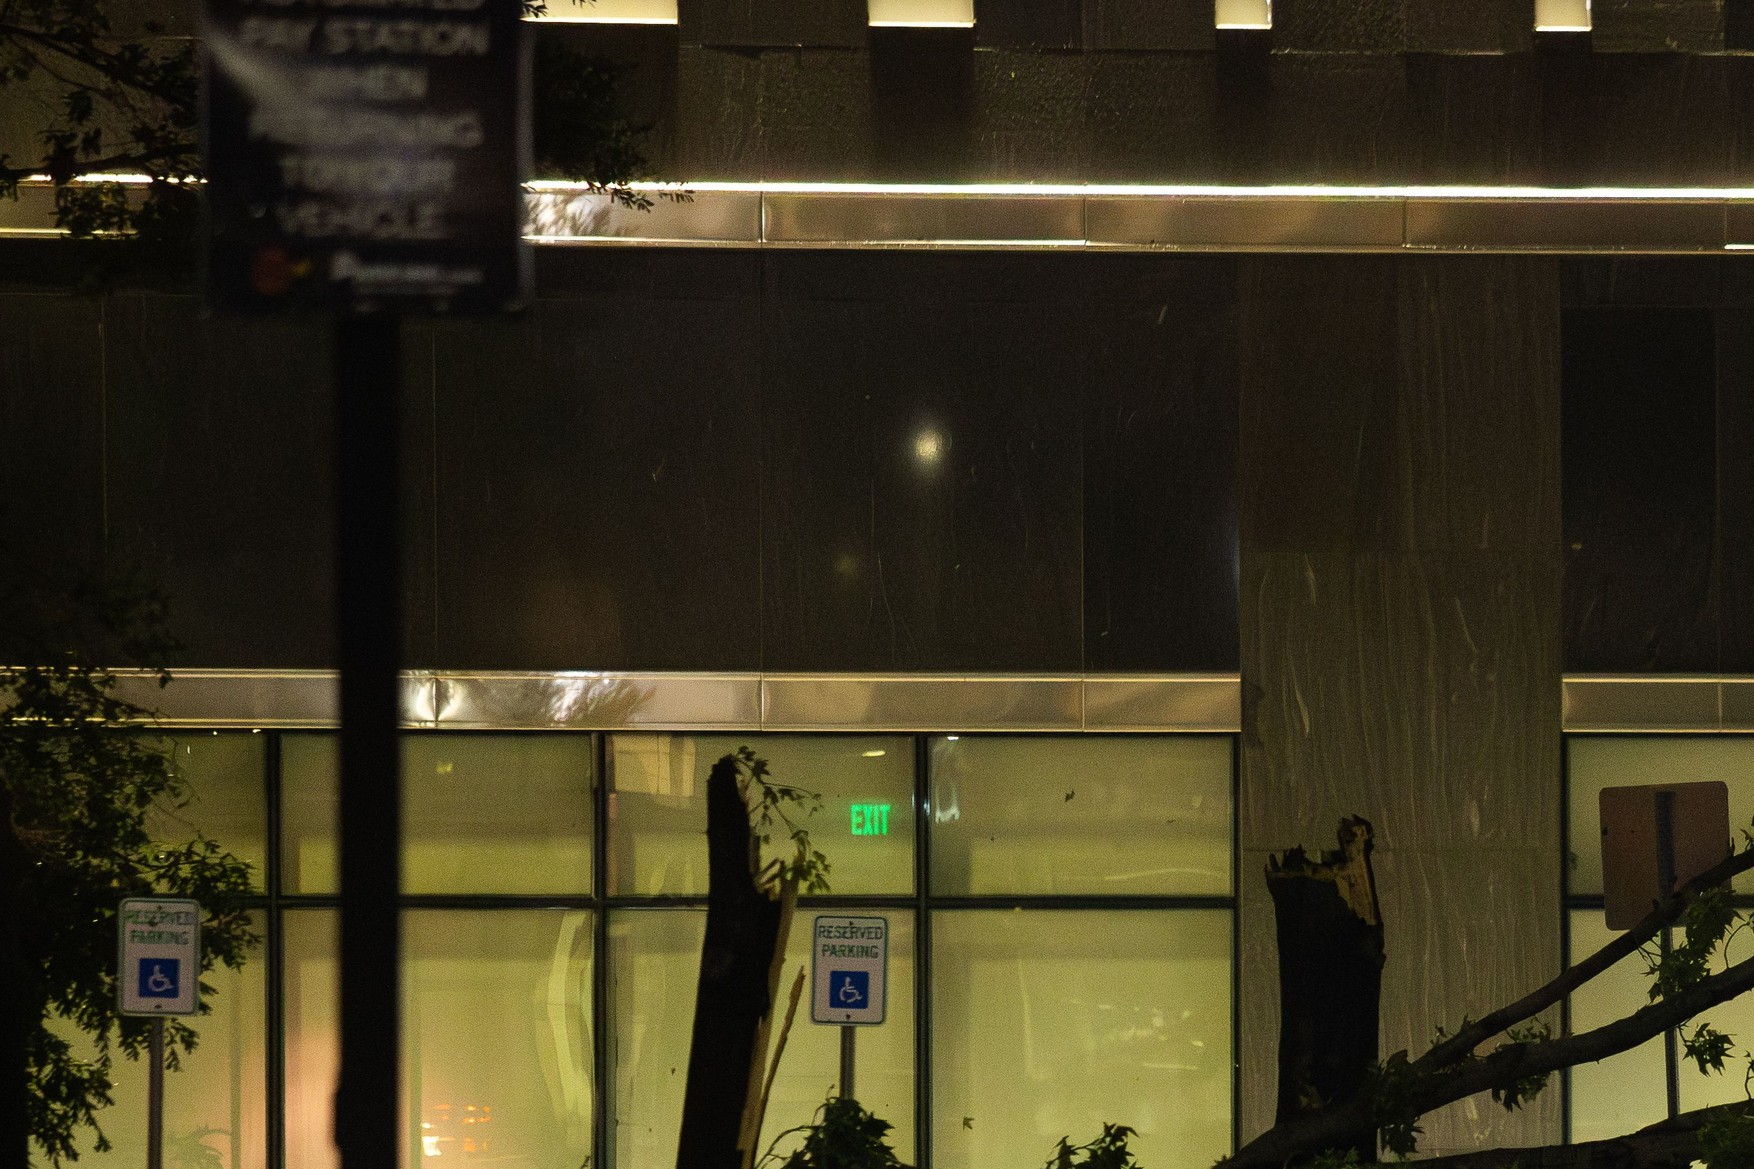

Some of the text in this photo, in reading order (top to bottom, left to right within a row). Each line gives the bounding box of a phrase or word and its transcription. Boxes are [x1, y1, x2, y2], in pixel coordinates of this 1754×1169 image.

[851, 804, 891, 835] EXIT
[818, 925, 883, 940] RESERVED
[821, 944, 880, 959] PARKING
